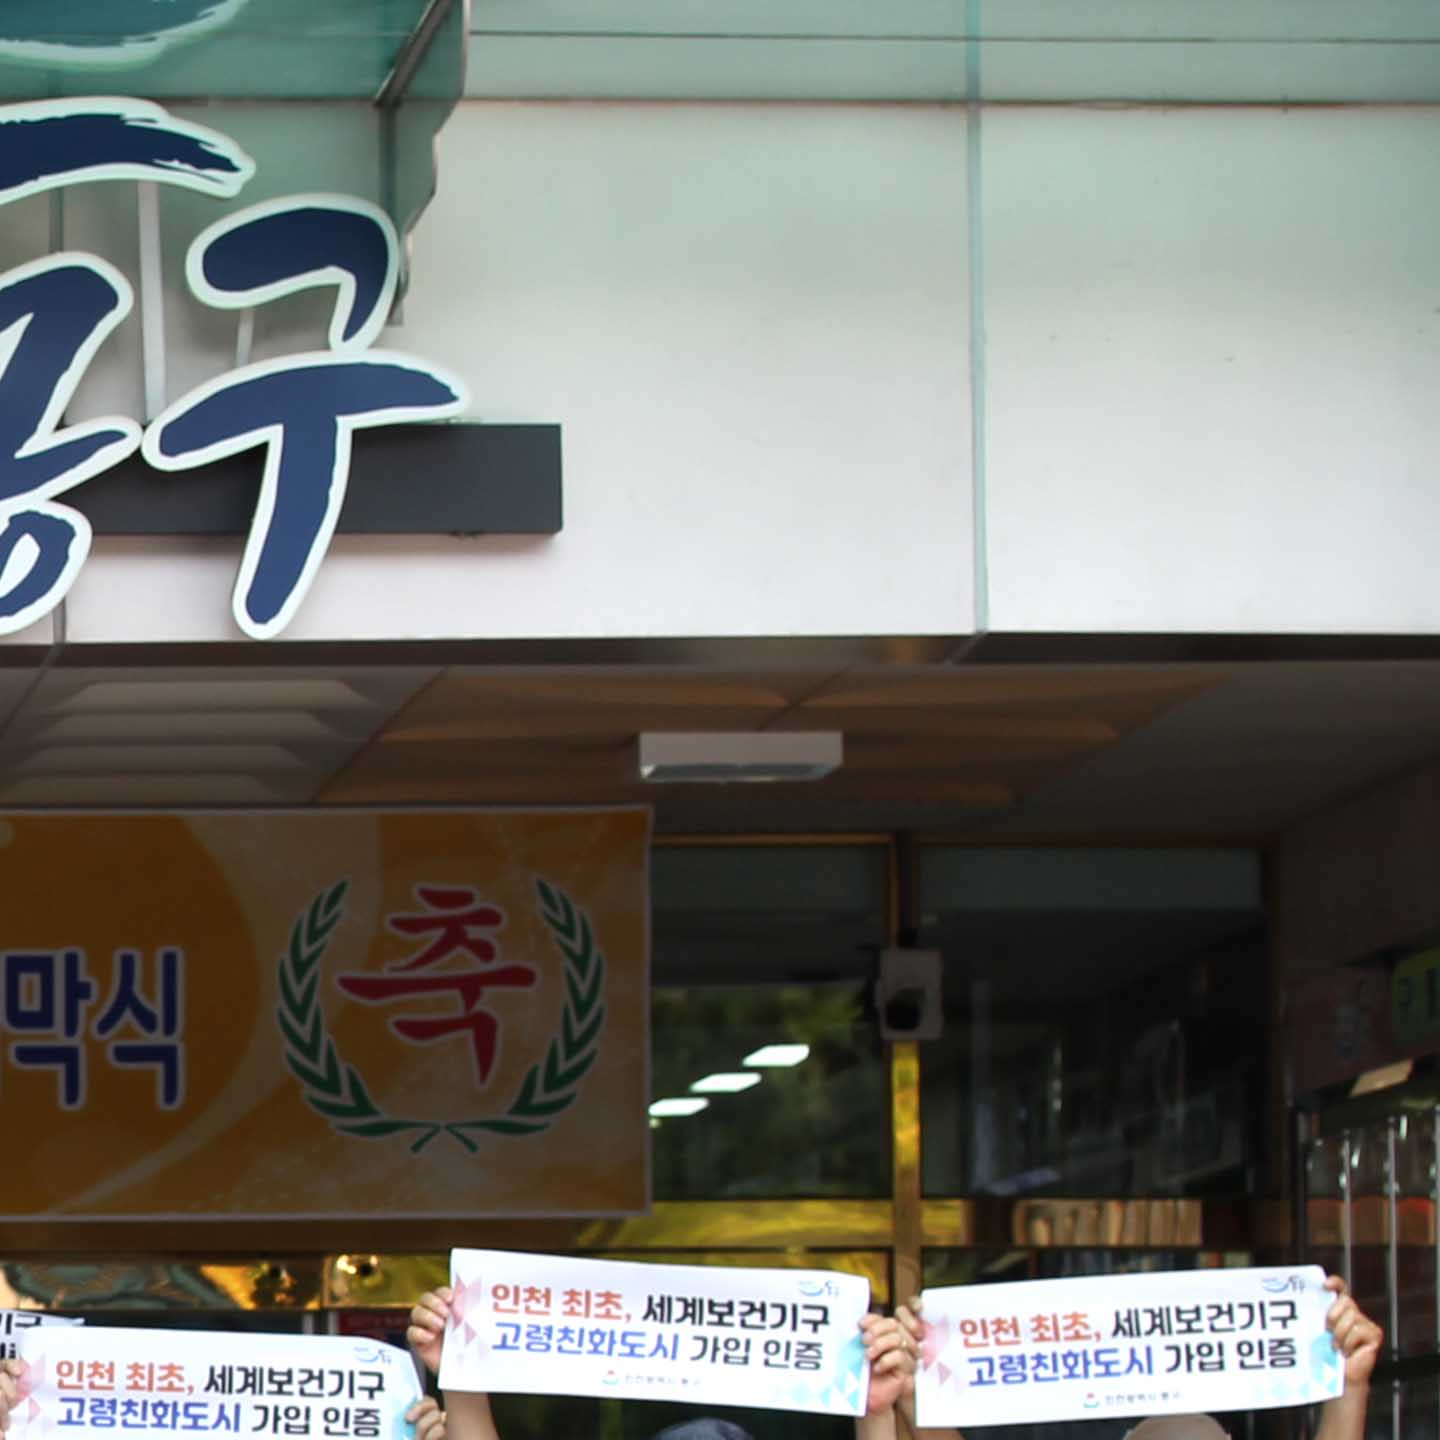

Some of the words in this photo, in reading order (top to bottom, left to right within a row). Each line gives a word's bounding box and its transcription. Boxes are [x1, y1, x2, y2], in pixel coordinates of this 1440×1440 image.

[338, 884, 536, 1087] 축
[492, 1284, 551, 1315] 인천
[563, 1289, 631, 1322] 최초,
[642, 1294, 830, 1334] 세계보건기구
[960, 1317, 1020, 1348] 인천
[1031, 1312, 1101, 1342] 최초,
[1111, 1300, 1298, 1339] 세계보건기구
[492, 1322, 679, 1360] 고령친화도시
[690, 1336, 751, 1366] 가입
[764, 1340, 822, 1370] 인증
[968, 1345, 1154, 1386] 고령친화도시
[1165, 1341, 1226, 1373] 가입
[1236, 1338, 1297, 1370] 인증
[56, 1361, 114, 1391] 인천
[126, 1362, 194, 1395] 최초,
[204, 1365, 385, 1400] 세계보건기구
[57, 1397, 241, 1432] 고령친화도시
[252, 1405, 311, 1435] 가입
[323, 1407, 381, 1438] 인증
